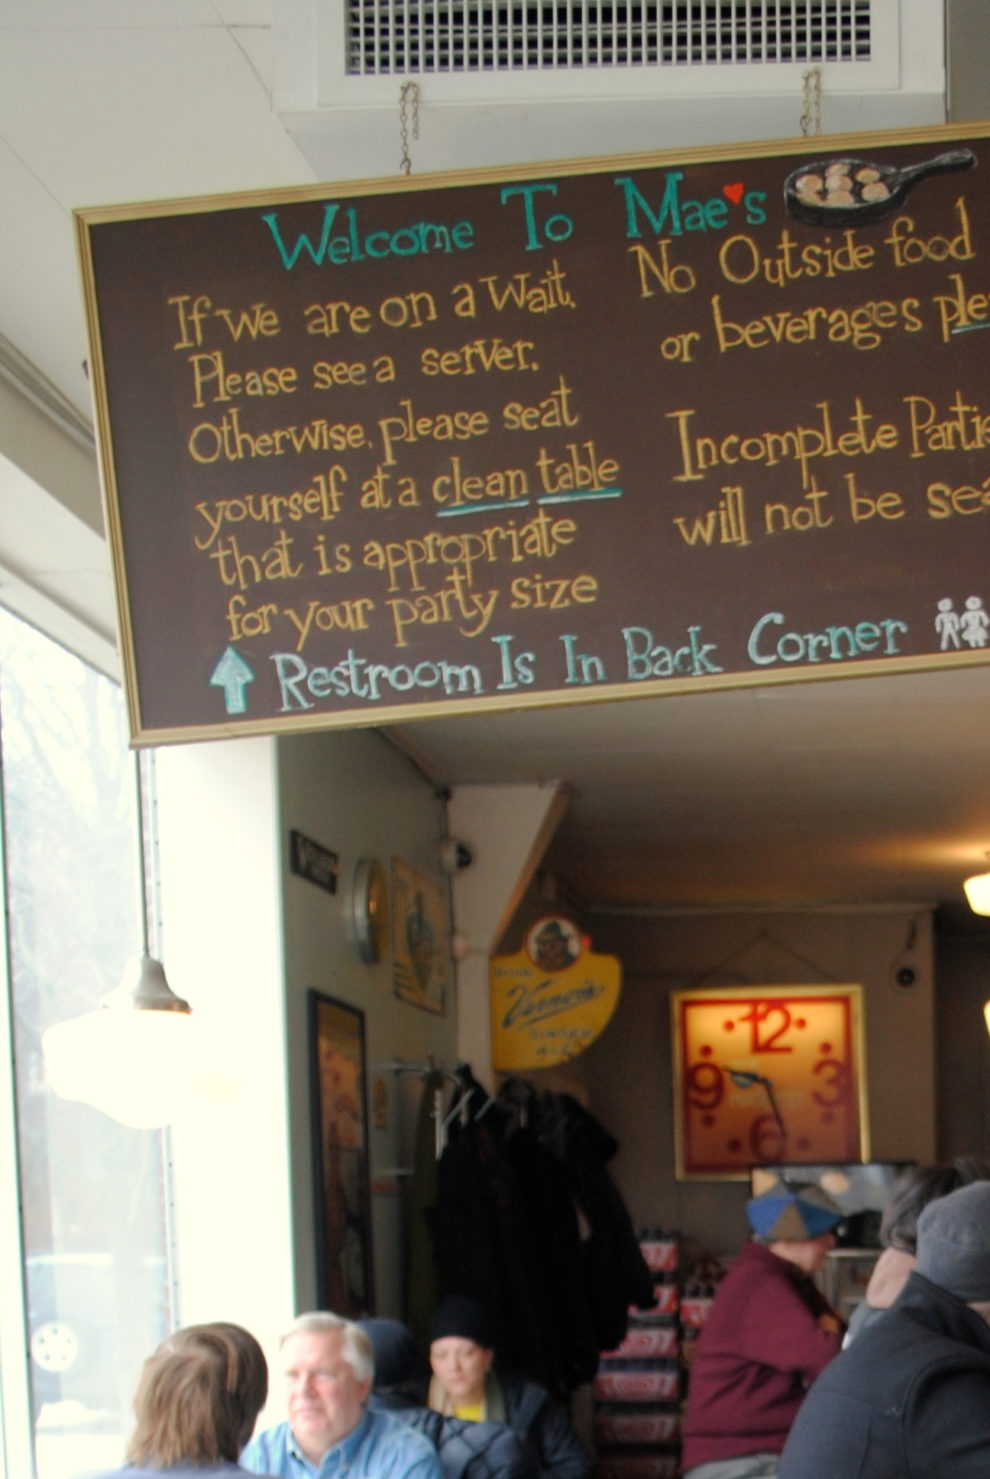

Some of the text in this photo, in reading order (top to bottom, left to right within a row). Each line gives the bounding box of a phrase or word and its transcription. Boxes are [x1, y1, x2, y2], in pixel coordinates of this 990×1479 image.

[262, 204, 474, 271] Welcome
[500, 184, 574, 251] To
[628, 197, 976, 298] No Outside food
[168, 295, 211, 350] If
[216, 302, 281, 342] we
[304, 297, 372, 338] are
[379, 291, 438, 329] on
[452, 282, 476, 319] a
[661, 328, 700, 363] or
[711, 295, 922, 352] beverages
[188, 337, 539, 408] Please see a server.
[378, 401, 490, 465] please
[502, 376, 580, 432] seat
[666, 398, 899, 490] Incomplete
[194, 442, 620, 550] yourself at a clean table
[674, 486, 751, 547] will
[764, 479, 835, 534] not
[844, 472, 906, 525] be
[210, 509, 577, 592] that is appropriate
[225, 566, 598, 652] for your party size
[270, 612, 908, 714] Restroom Is In Back Corner
[739, 1000, 794, 1055] 12
[687, 1061, 726, 1112] 9
[811, 1058, 847, 1109] 3
[750, 1112, 788, 1163] 6
